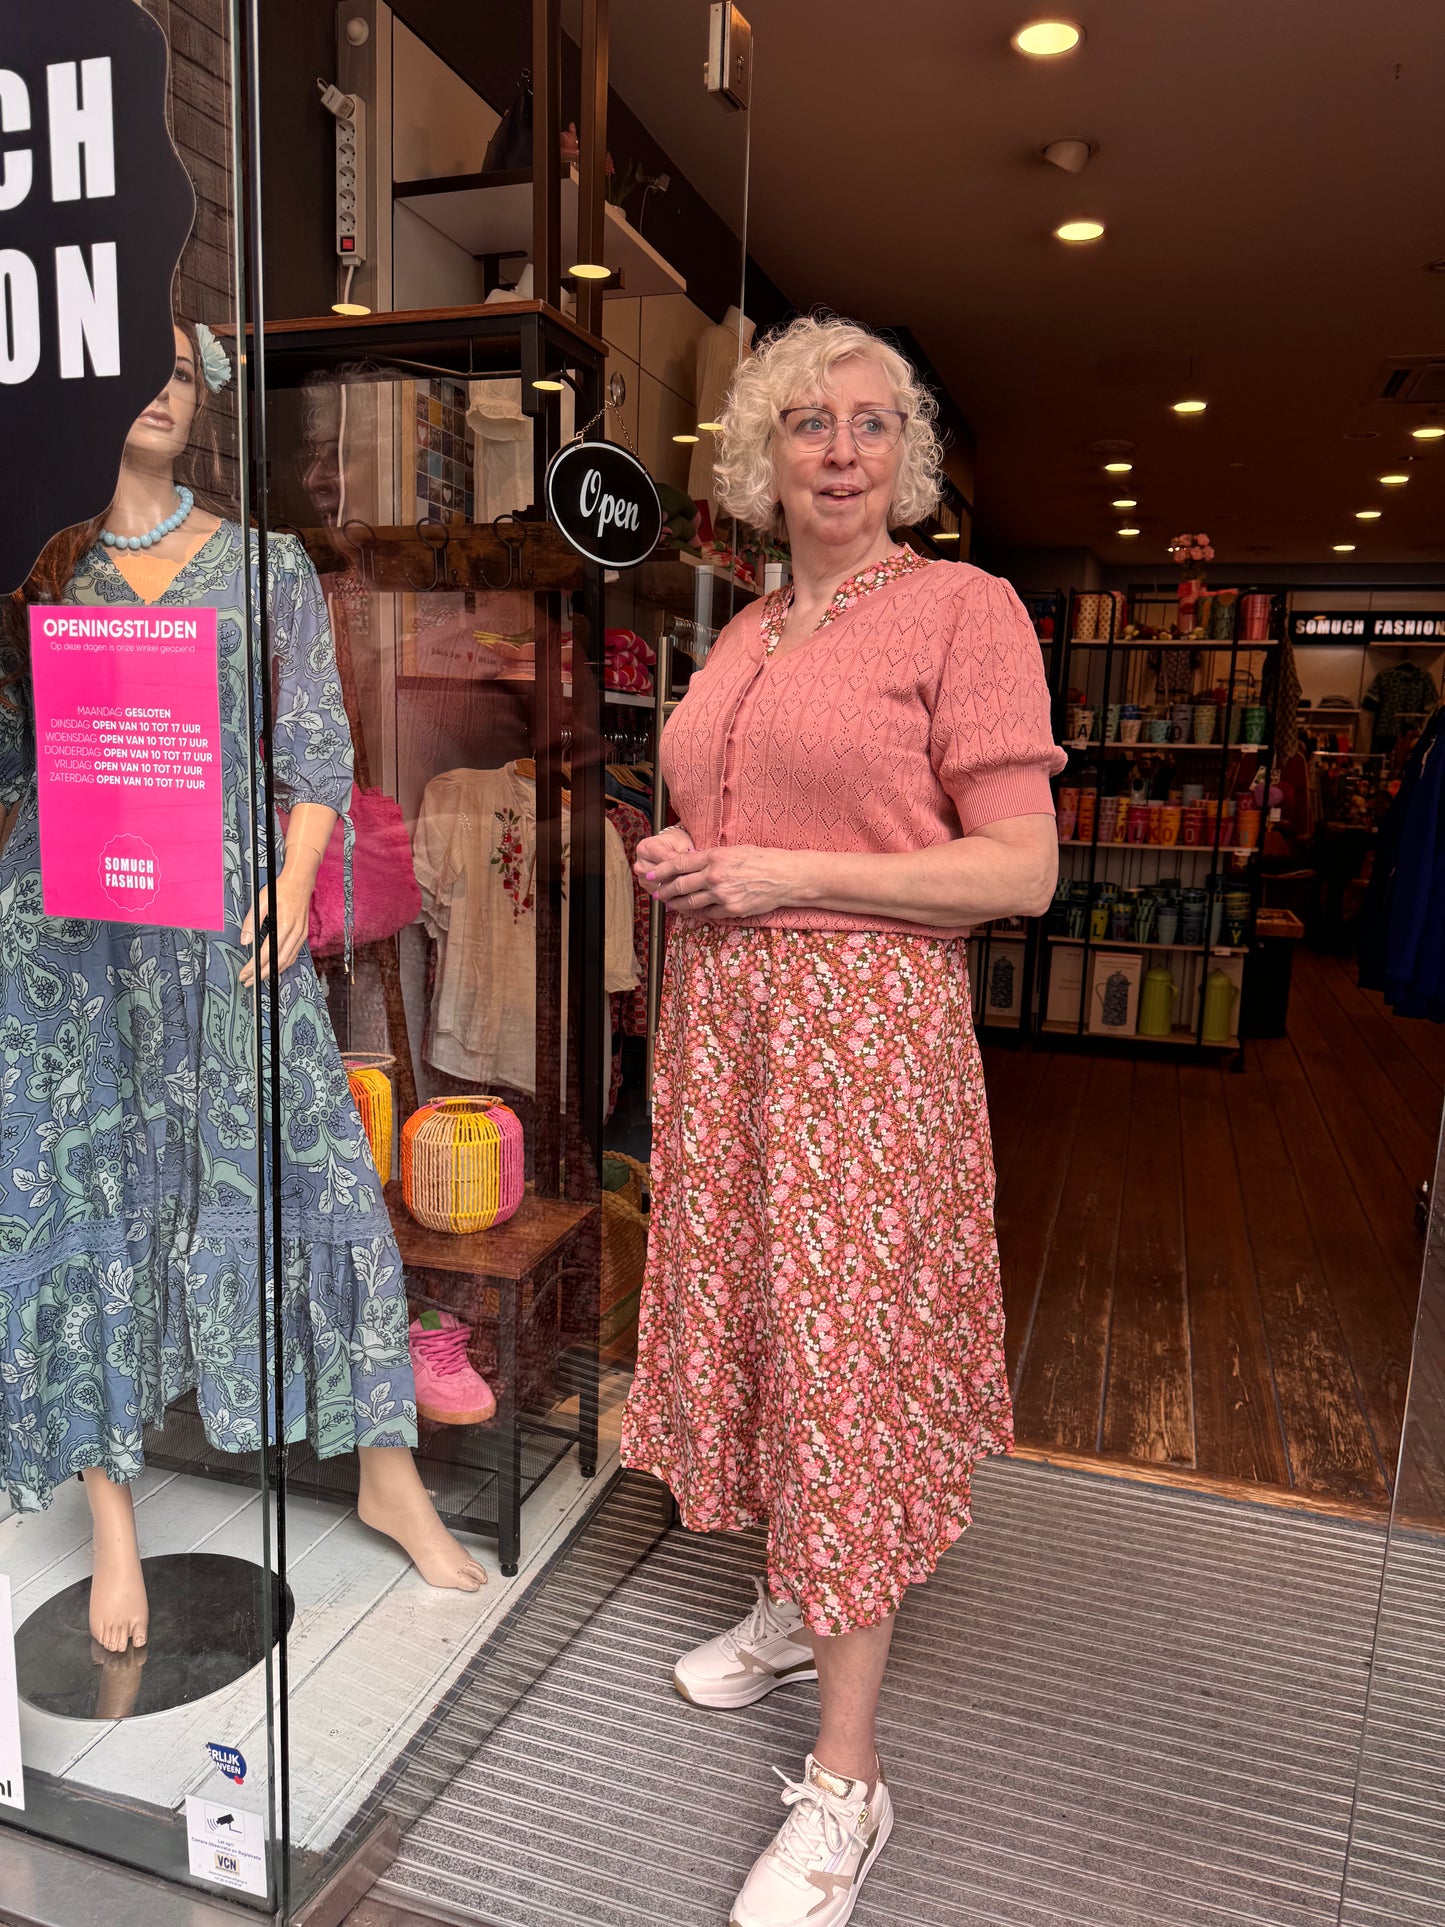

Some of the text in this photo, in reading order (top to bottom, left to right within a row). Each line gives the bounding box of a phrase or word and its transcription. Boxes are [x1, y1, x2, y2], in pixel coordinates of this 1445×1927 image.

[580, 468, 640, 538] Open
[43, 618, 197, 638] OPENINGSTIJDEN
[1296, 620, 1445, 636] SOMUCH FASHION
[51, 642, 62, 651] Op
[83, 643, 106, 652] dagen
[136, 644, 158, 652] winkel
[160, 645, 195, 654] geopend
[77, 706, 171, 718] MAANDAG GESLOTEN
[51, 719, 201, 734] DINSDAG OPEN VAN 10 TOT 17 UUR
[45, 732, 208, 748] WOENSDAG OPEN VAN 10 TOT 17 UUR
[44, 745, 212, 762] DONDERDAG OPEN VAN 10 TOT 17 UUR
[54, 759, 202, 776] VRIJDAG OPEN VAN 10 TOT 17 UUR
[50, 772, 205, 790] ZATERDAG OPEN VAN 10 TOT 17 UUR
[105, 857, 154, 873] SOMUCH
[106, 874, 154, 890] FASHION
[218, 1854, 237, 1871] VCN
